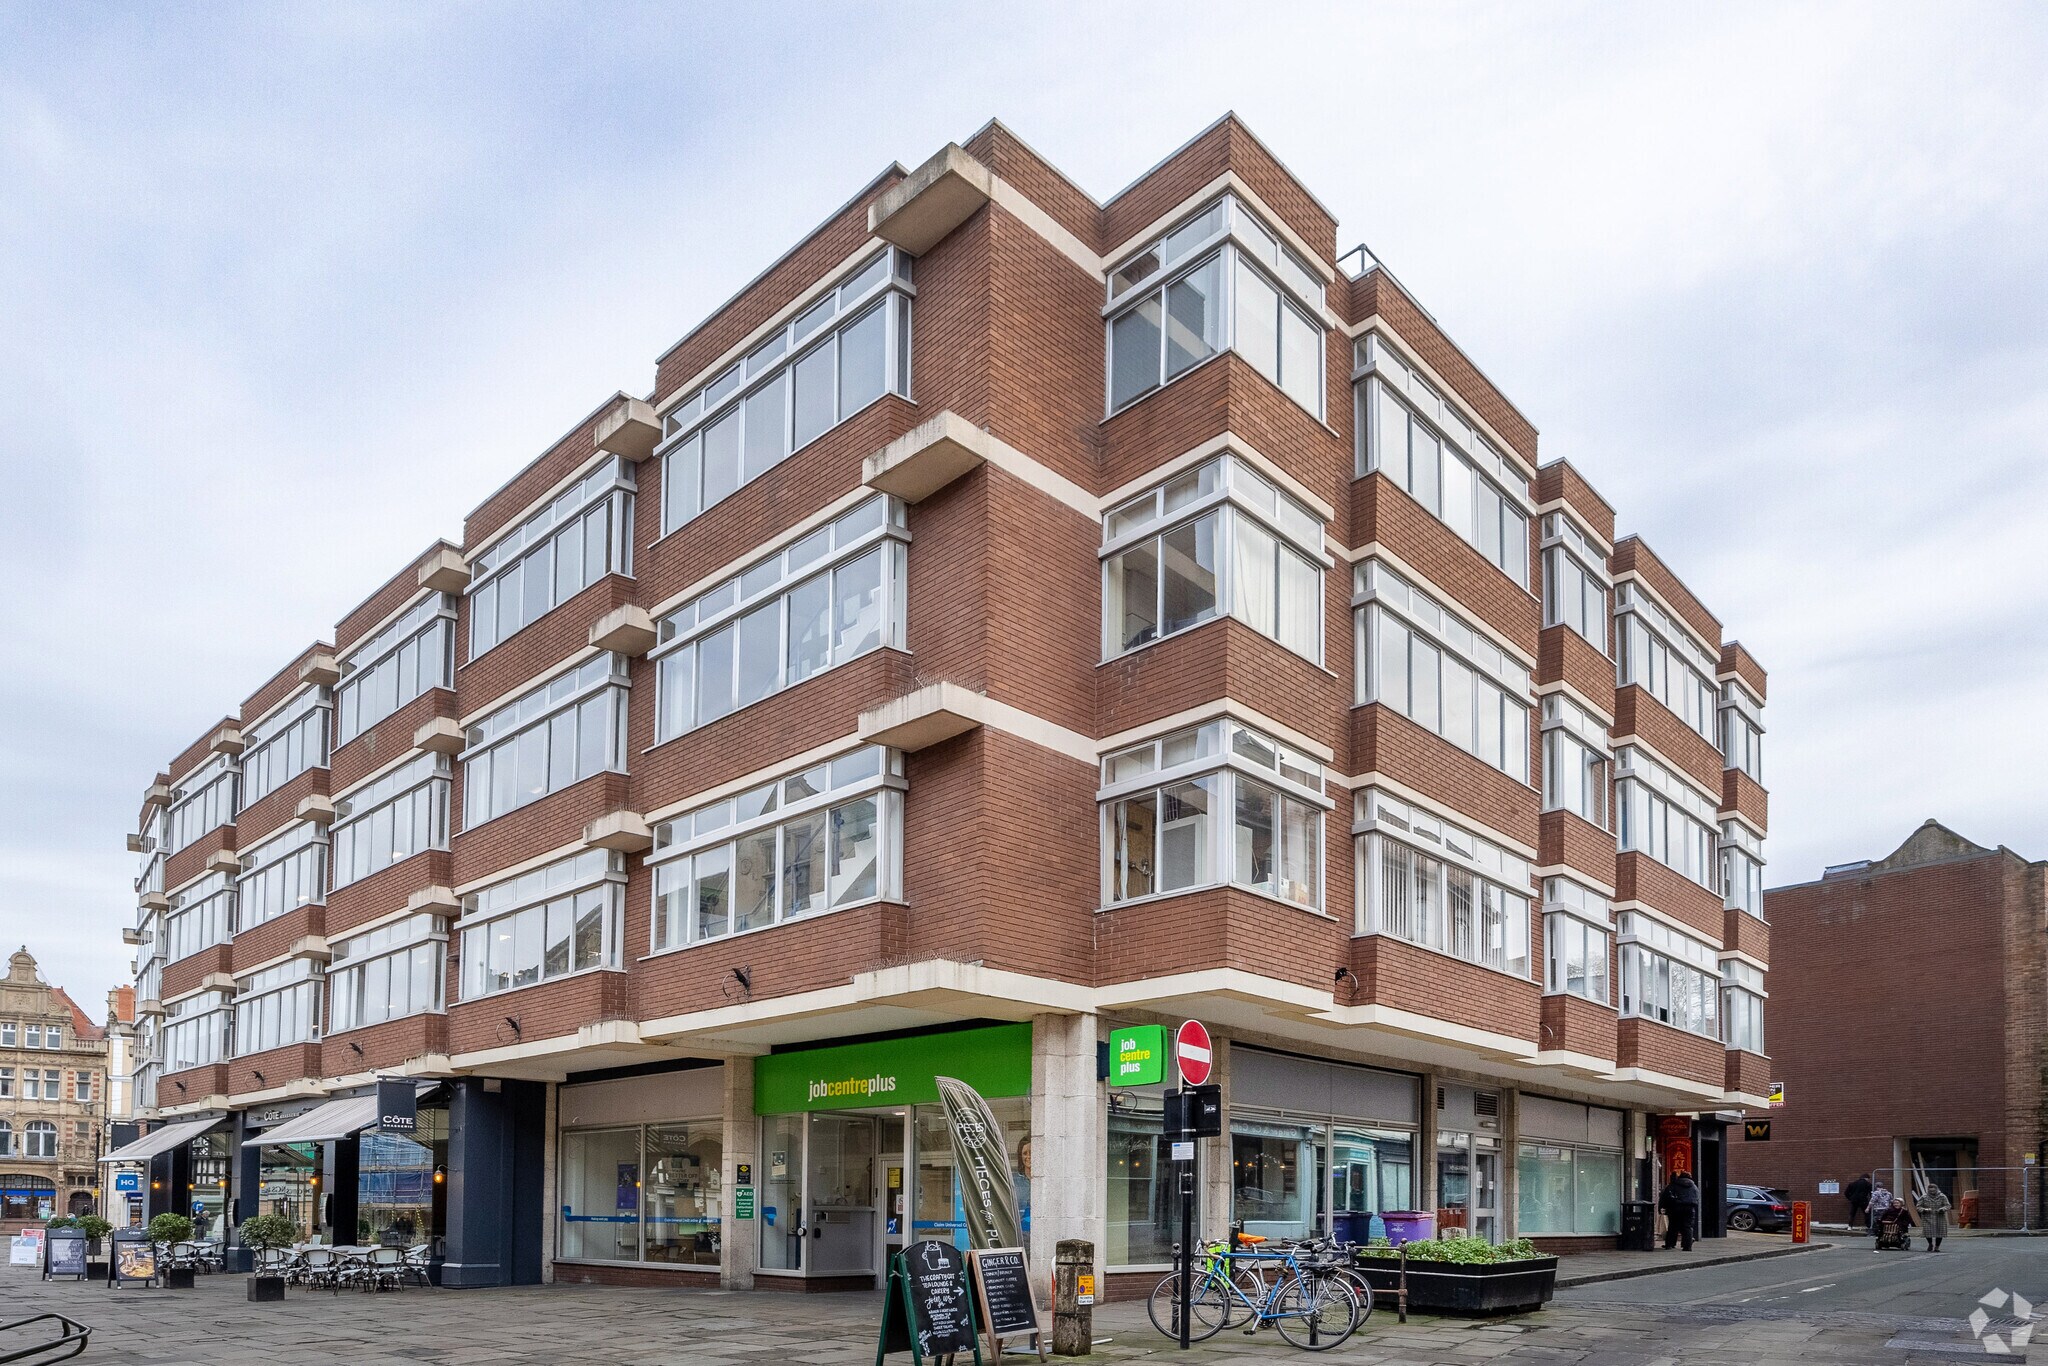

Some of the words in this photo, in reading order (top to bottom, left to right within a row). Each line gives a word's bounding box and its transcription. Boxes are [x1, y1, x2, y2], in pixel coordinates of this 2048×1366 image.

[1120, 1038, 1136, 1052] job
[1120, 1049, 1150, 1062] centre
[1120, 1062, 1140, 1076] plus
[808, 1073, 896, 1102] jobcentreplus
[382, 1114, 413, 1125] CÔTE
[1747, 1124, 1768, 1137] W
[975, 1156, 992, 1209] PIECES
[1795, 1214, 1803, 1238] OPEN
[981, 1257, 1005, 1269] GINGER
[919, 1274, 930, 1282] THE
